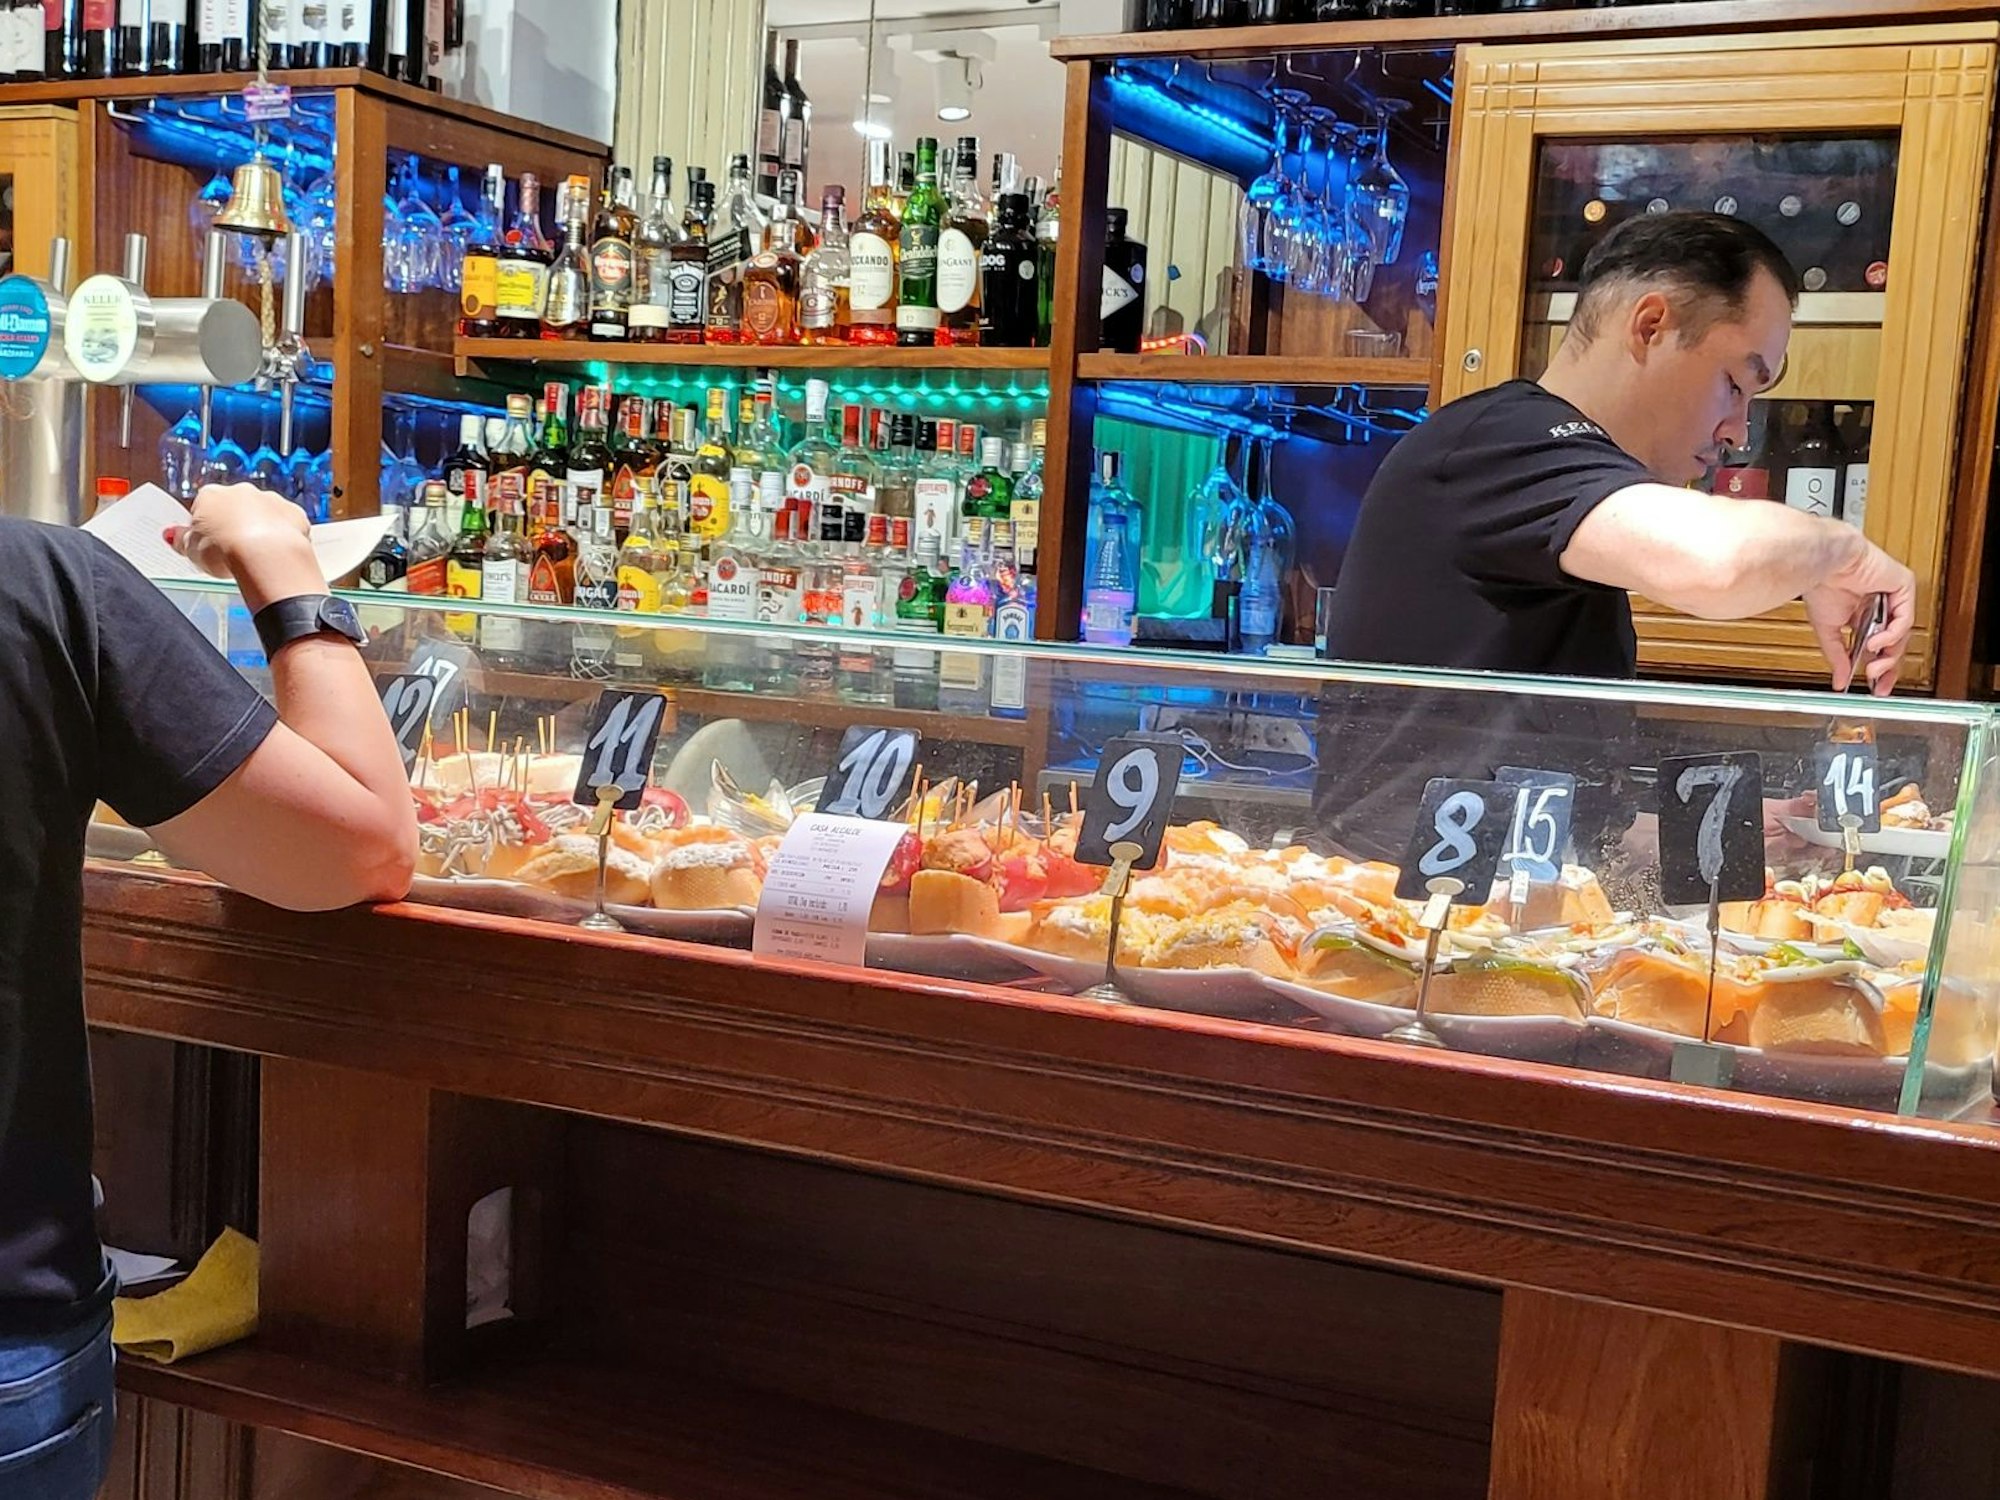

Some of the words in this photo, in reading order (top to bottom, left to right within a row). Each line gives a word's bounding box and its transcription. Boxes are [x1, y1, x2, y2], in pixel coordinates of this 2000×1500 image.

[1101, 287, 1128, 298] CK'S
[1003, 613, 1023, 622] BOMBAY
[383, 676, 436, 763] 12
[589, 695, 663, 791] 11
[825, 730, 915, 819] 10
[1103, 748, 1159, 841] 9
[1823, 753, 1874, 817] 14
[810, 823, 828, 832] CASA
[1419, 791, 1484, 876] 8
[1502, 788, 1568, 863] 15
[1676, 765, 1743, 884] 7
